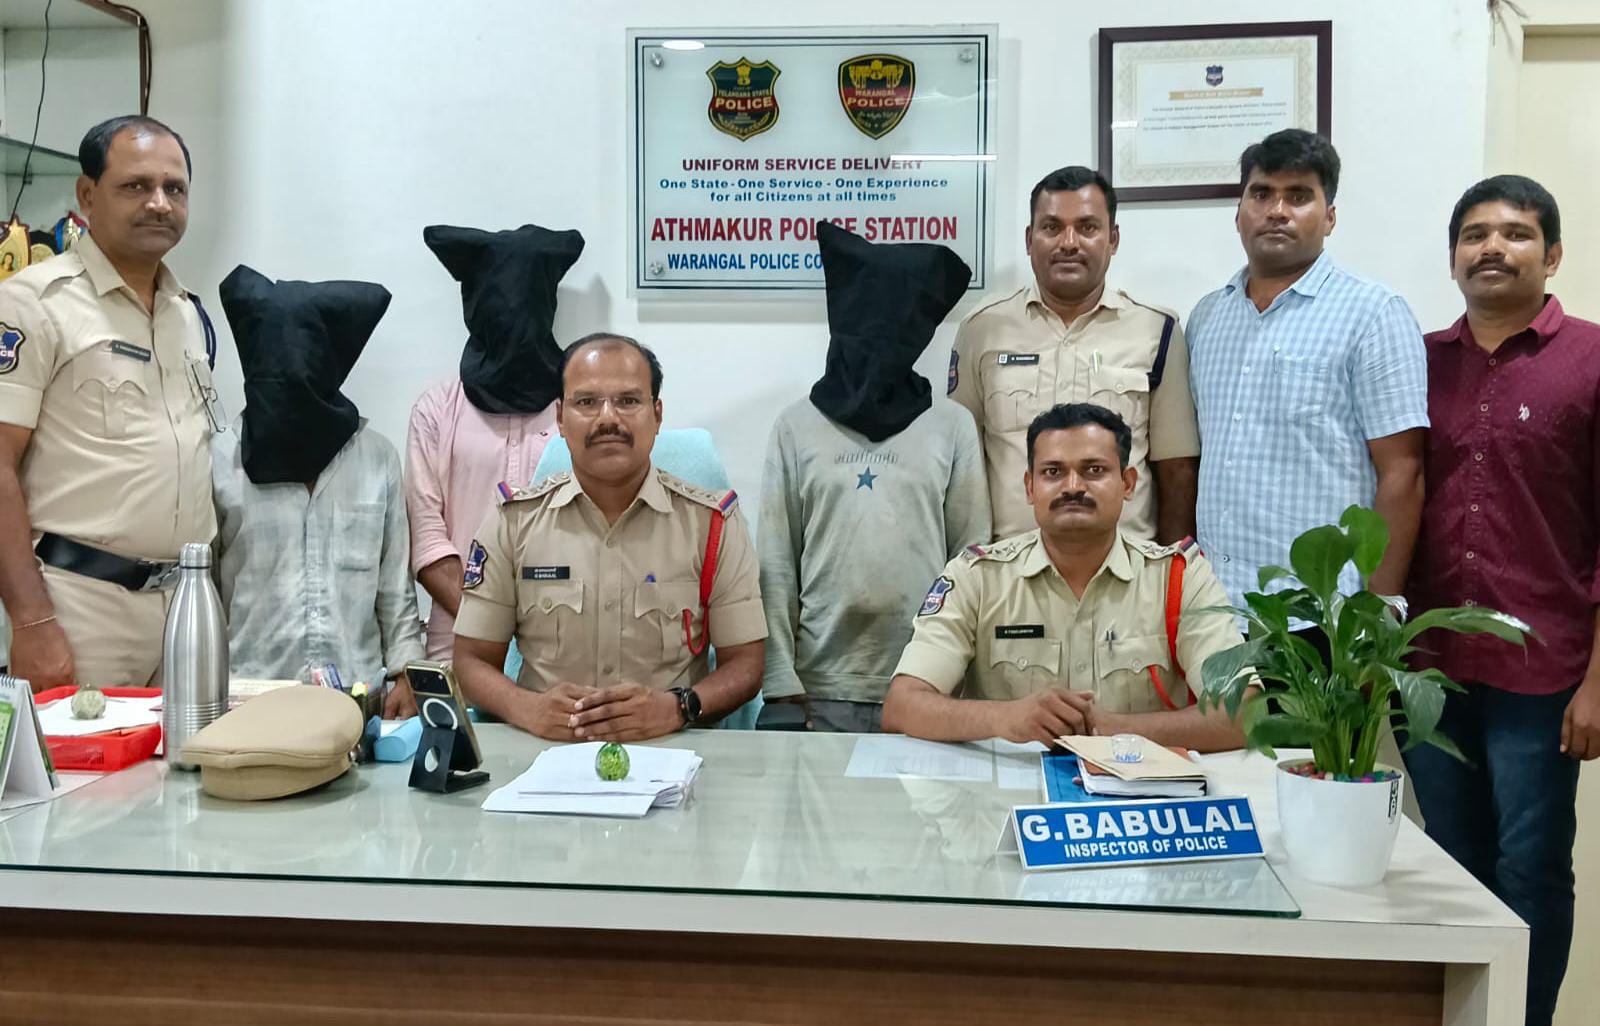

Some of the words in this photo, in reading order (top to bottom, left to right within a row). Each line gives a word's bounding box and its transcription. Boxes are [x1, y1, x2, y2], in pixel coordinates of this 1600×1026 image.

[715, 96, 773, 110] POLICE
[847, 97, 905, 107] POLICE
[682, 159, 759, 171] UNIFORM
[764, 158, 836, 170] SERVICE
[660, 179, 686, 188] One
[692, 179, 728, 188] State
[738, 179, 764, 188] One
[770, 178, 822, 188] Service
[835, 178, 862, 188] One
[867, 178, 948, 190] Experience
[710, 192, 730, 202] for
[734, 192, 751, 202] all
[756, 192, 813, 202] Citizens
[817, 192, 831, 201] at
[836, 192, 852, 201] all
[857, 192, 896, 201] times
[651, 218, 772, 241] ATHMAKUR
[865, 216, 957, 240] STATION
[668, 254, 746, 269] WARANGAL
[750, 254, 800, 269] POLICE
[1022, 804, 1254, 842] G.BABULAL
[1064, 841, 1149, 858] INSPECTOR
[1152, 838, 1171, 852] OF
[1176, 836, 1228, 852] POLICE
